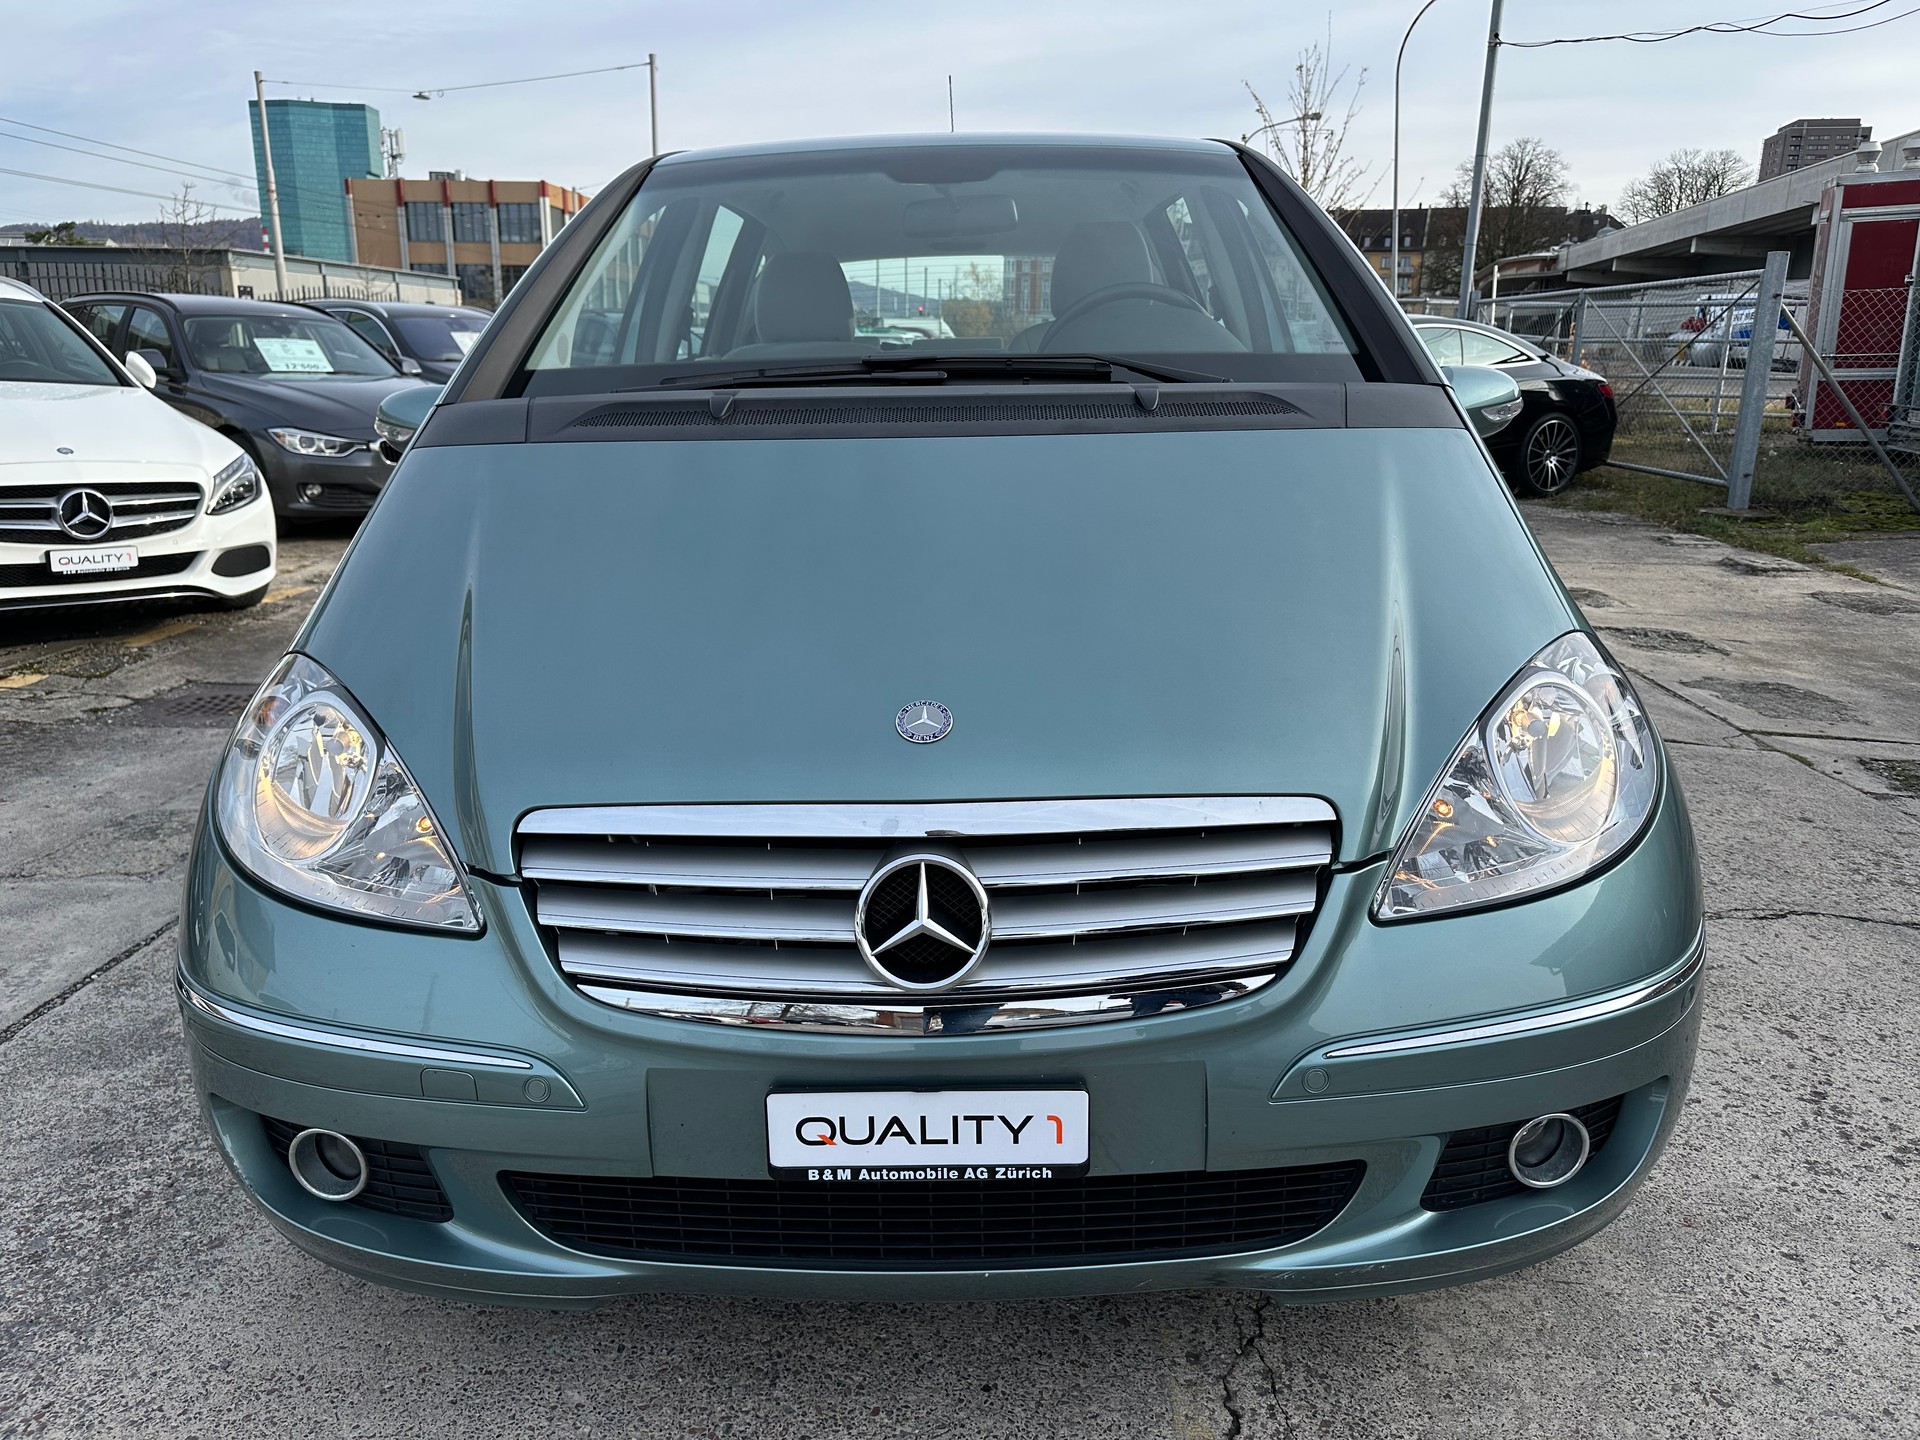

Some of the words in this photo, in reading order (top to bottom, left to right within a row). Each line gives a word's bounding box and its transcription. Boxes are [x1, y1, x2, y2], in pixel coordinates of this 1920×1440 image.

[58, 553, 123, 566] QUALITY
[126, 552, 132, 561] 1
[795, 1115, 1034, 1146] QUALITY
[1047, 1115, 1063, 1144] 1
[858, 1168, 959, 1180] Automobile
[963, 1168, 988, 1179] AG
[995, 1167, 1052, 1179] Zürich
